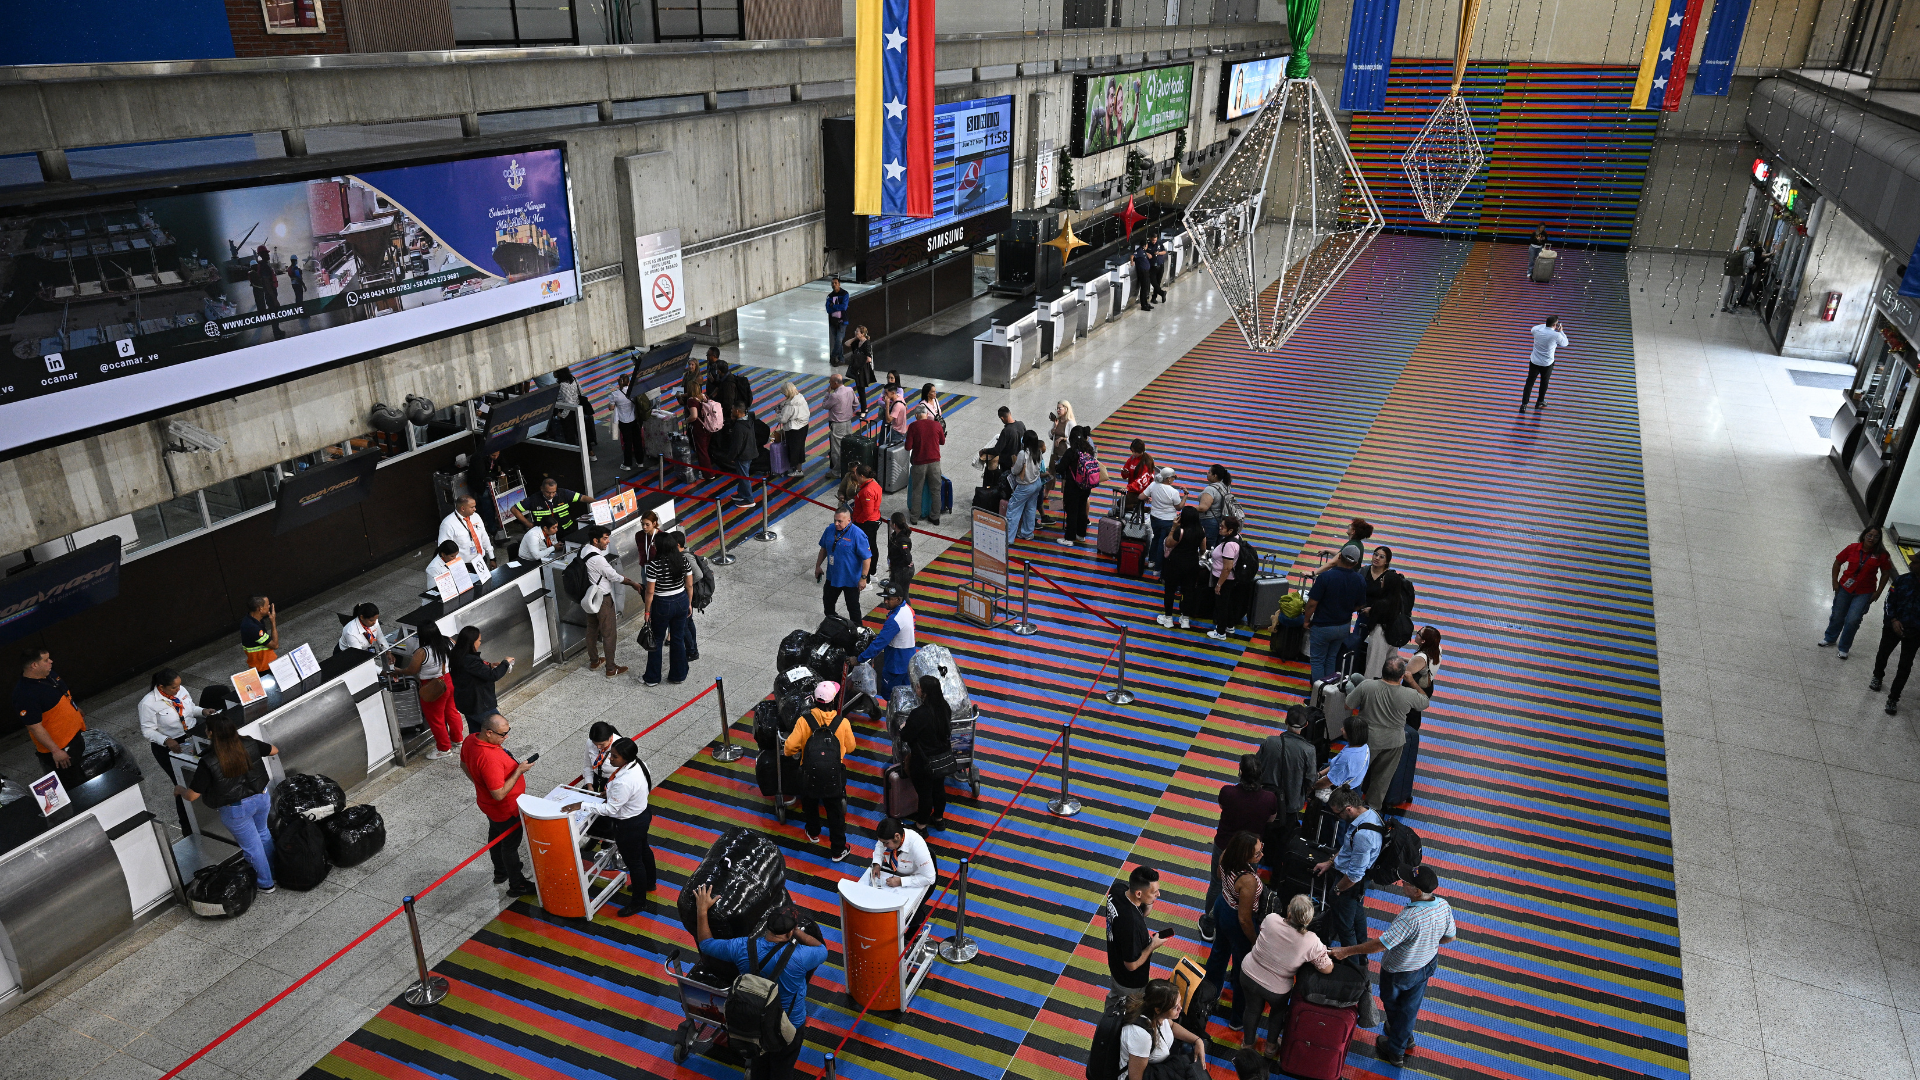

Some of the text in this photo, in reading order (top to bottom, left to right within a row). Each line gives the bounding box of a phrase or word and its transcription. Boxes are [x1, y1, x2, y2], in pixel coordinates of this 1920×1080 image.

[984, 130, 1008, 146] 11:58
[927, 226, 964, 252] SAMSUNG
[359, 291, 370, 301] +58
[370, 288, 385, 299] 0424
[386, 286, 396, 296] 185
[412, 280, 423, 289] +58
[423, 277, 437, 287] 0424
[437, 275, 447, 284] 273
[222, 306, 304, 331] WWW.OCAMAR.COM.VE
[99, 352, 159, 373] @ocamar_ve
[40, 371, 78, 386] ocamar
[0, 561, 115, 618] onviasa
[57, 588, 80, 602] placer
[81, 583, 90, 591] de
